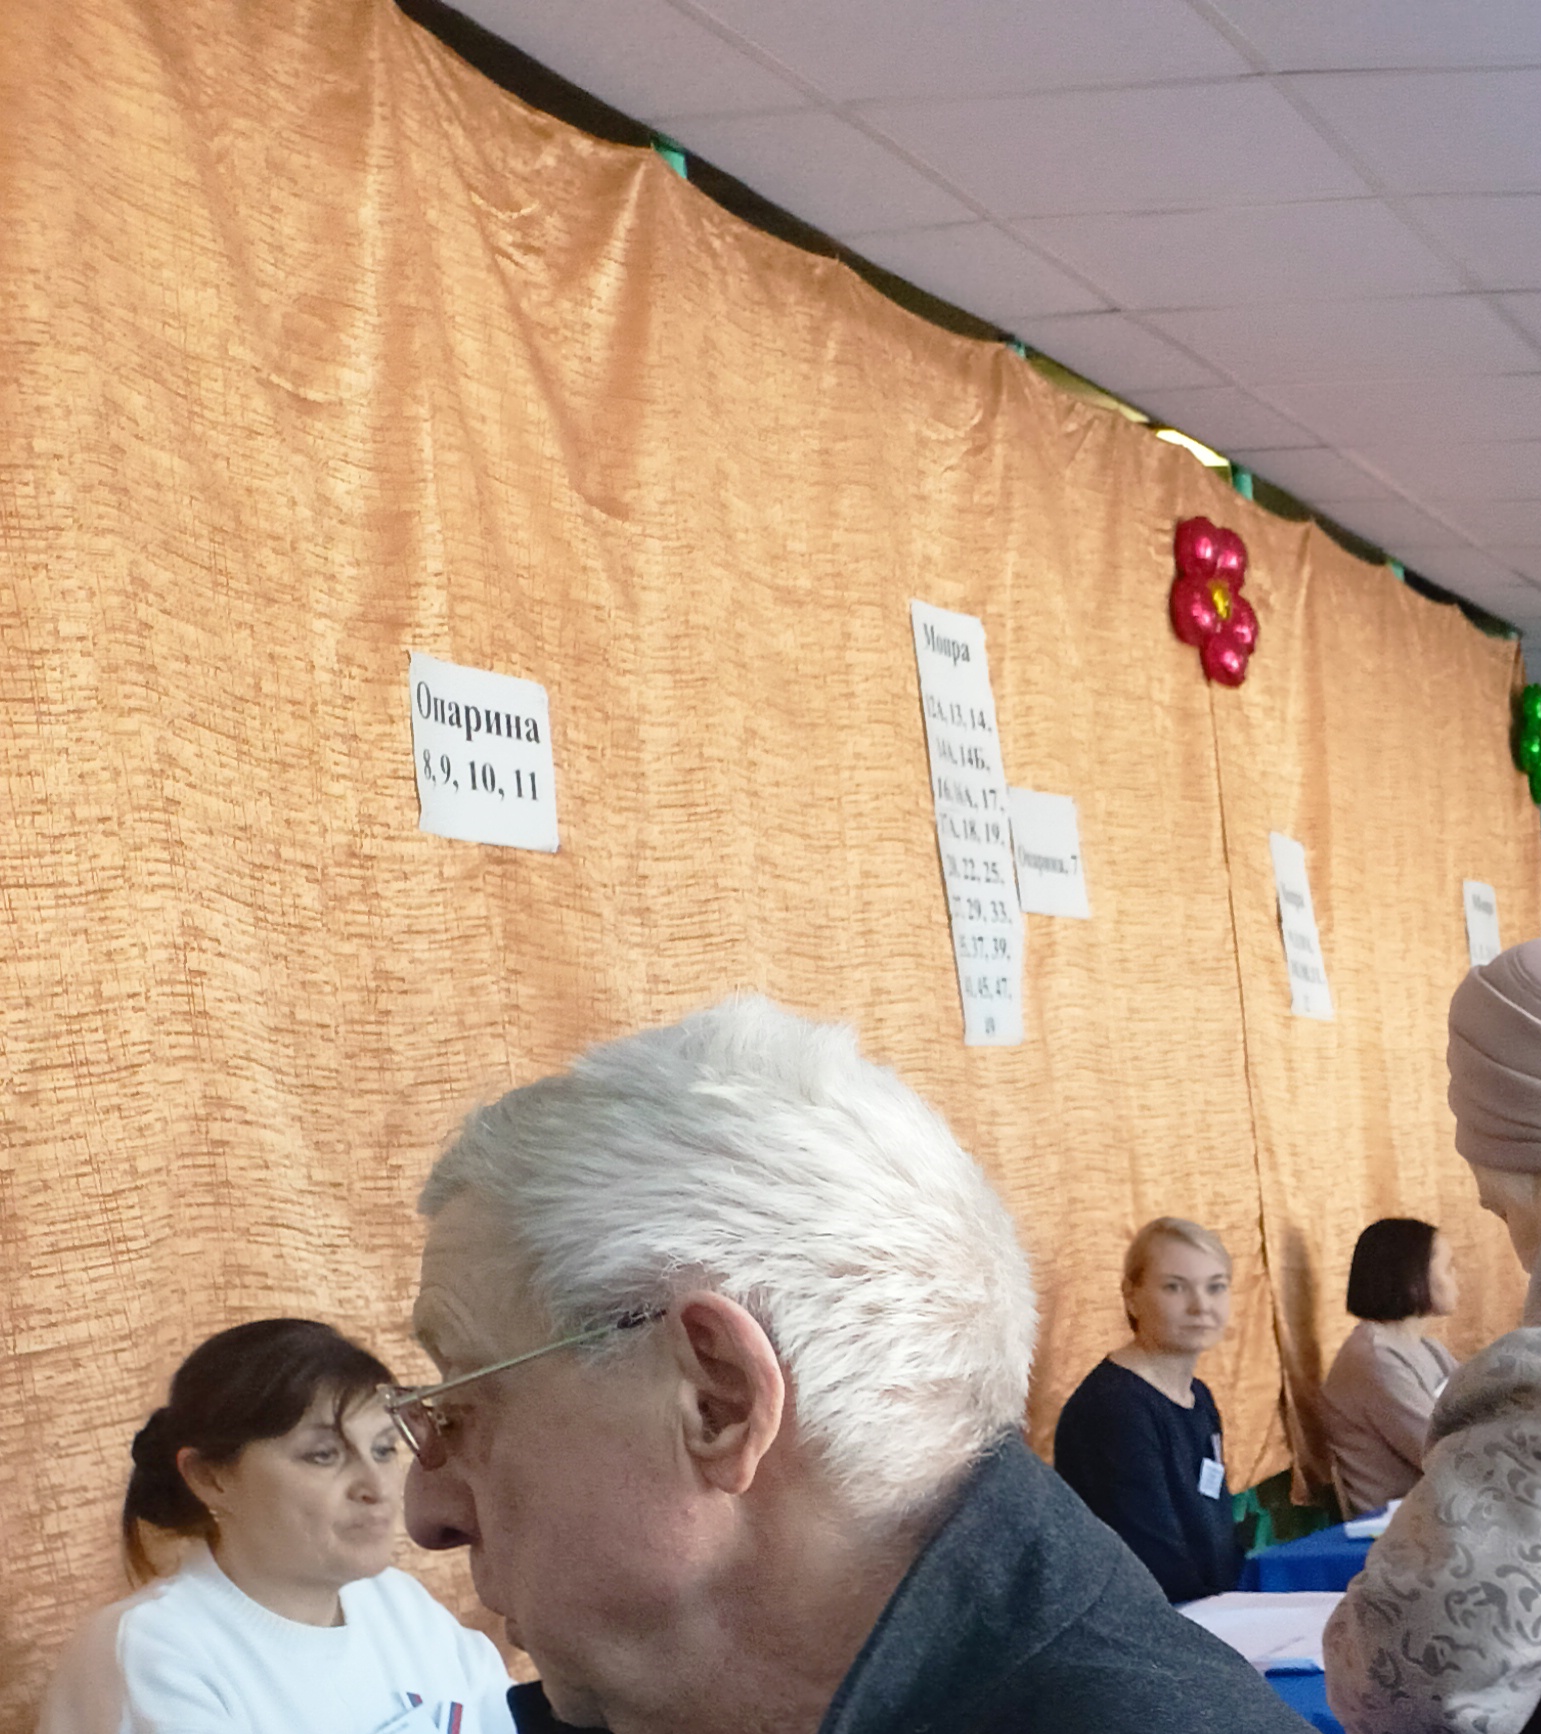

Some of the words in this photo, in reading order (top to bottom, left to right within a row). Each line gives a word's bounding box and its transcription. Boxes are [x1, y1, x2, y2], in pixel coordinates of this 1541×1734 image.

[416, 680, 541, 744] Опарина
[469, 760, 505, 801] 10,
[515, 769, 539, 801] 11
